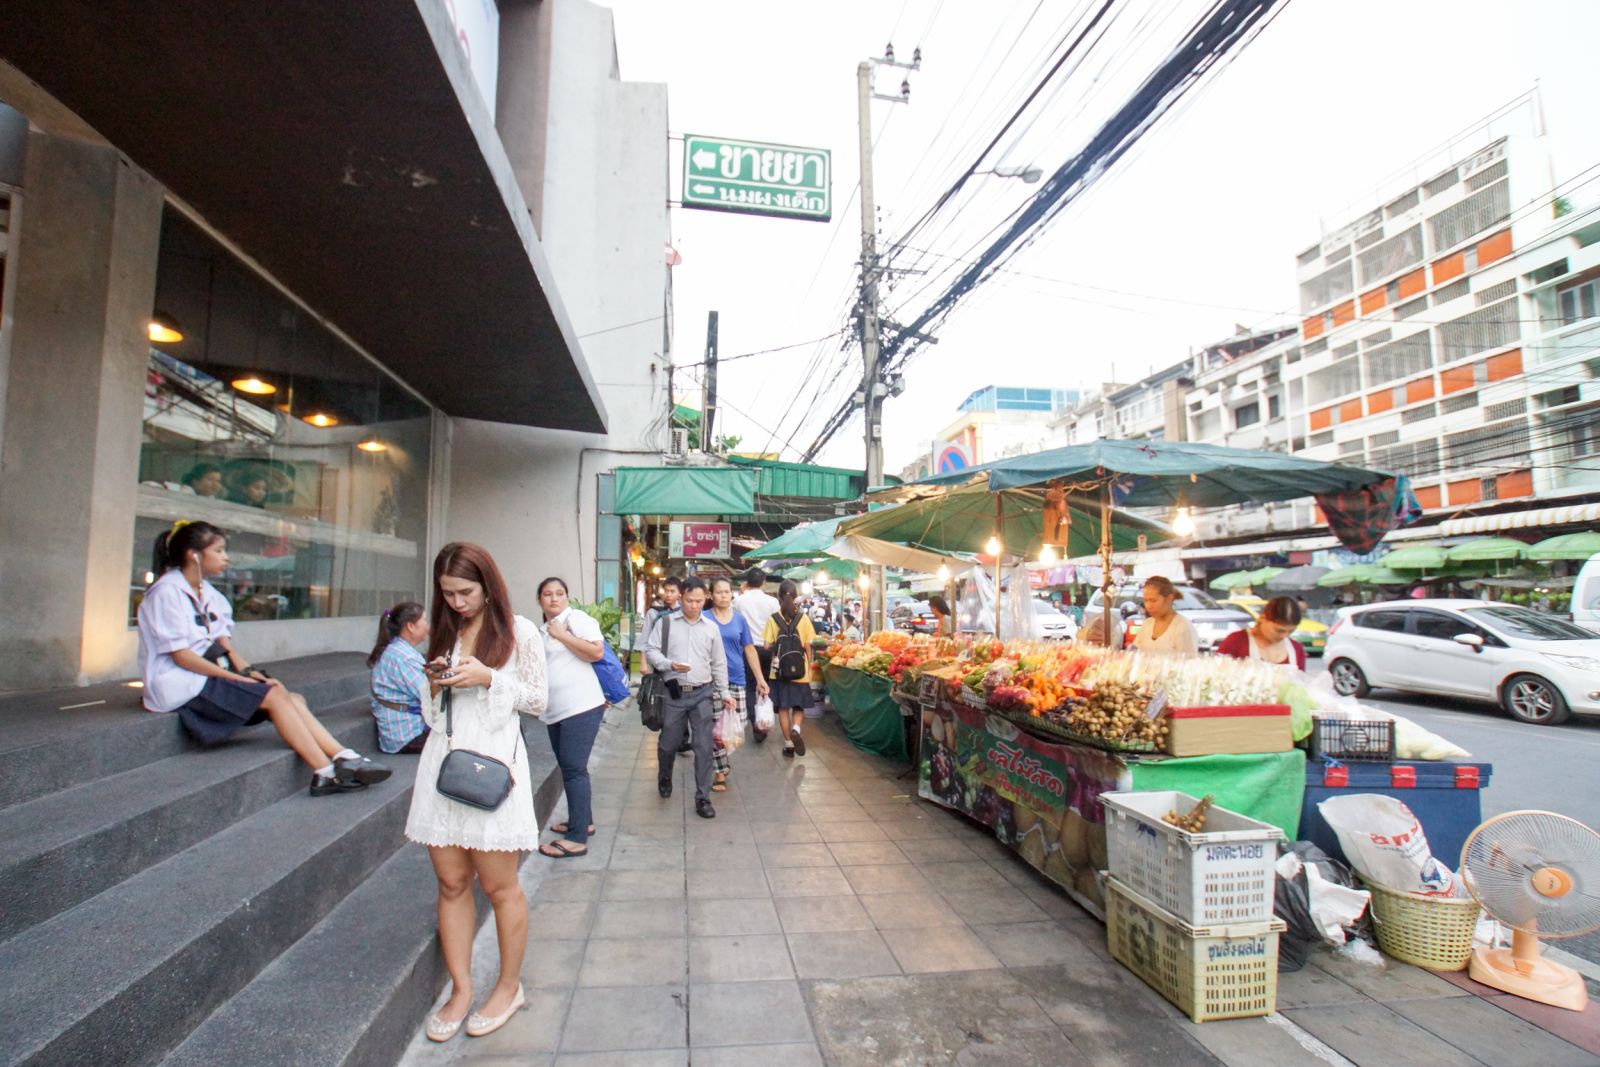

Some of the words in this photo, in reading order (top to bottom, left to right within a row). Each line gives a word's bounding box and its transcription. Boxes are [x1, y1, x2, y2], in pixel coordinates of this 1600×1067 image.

[718, 145, 824, 188] ขายยา
[719, 187, 824, 210] นมผงเด็ก
